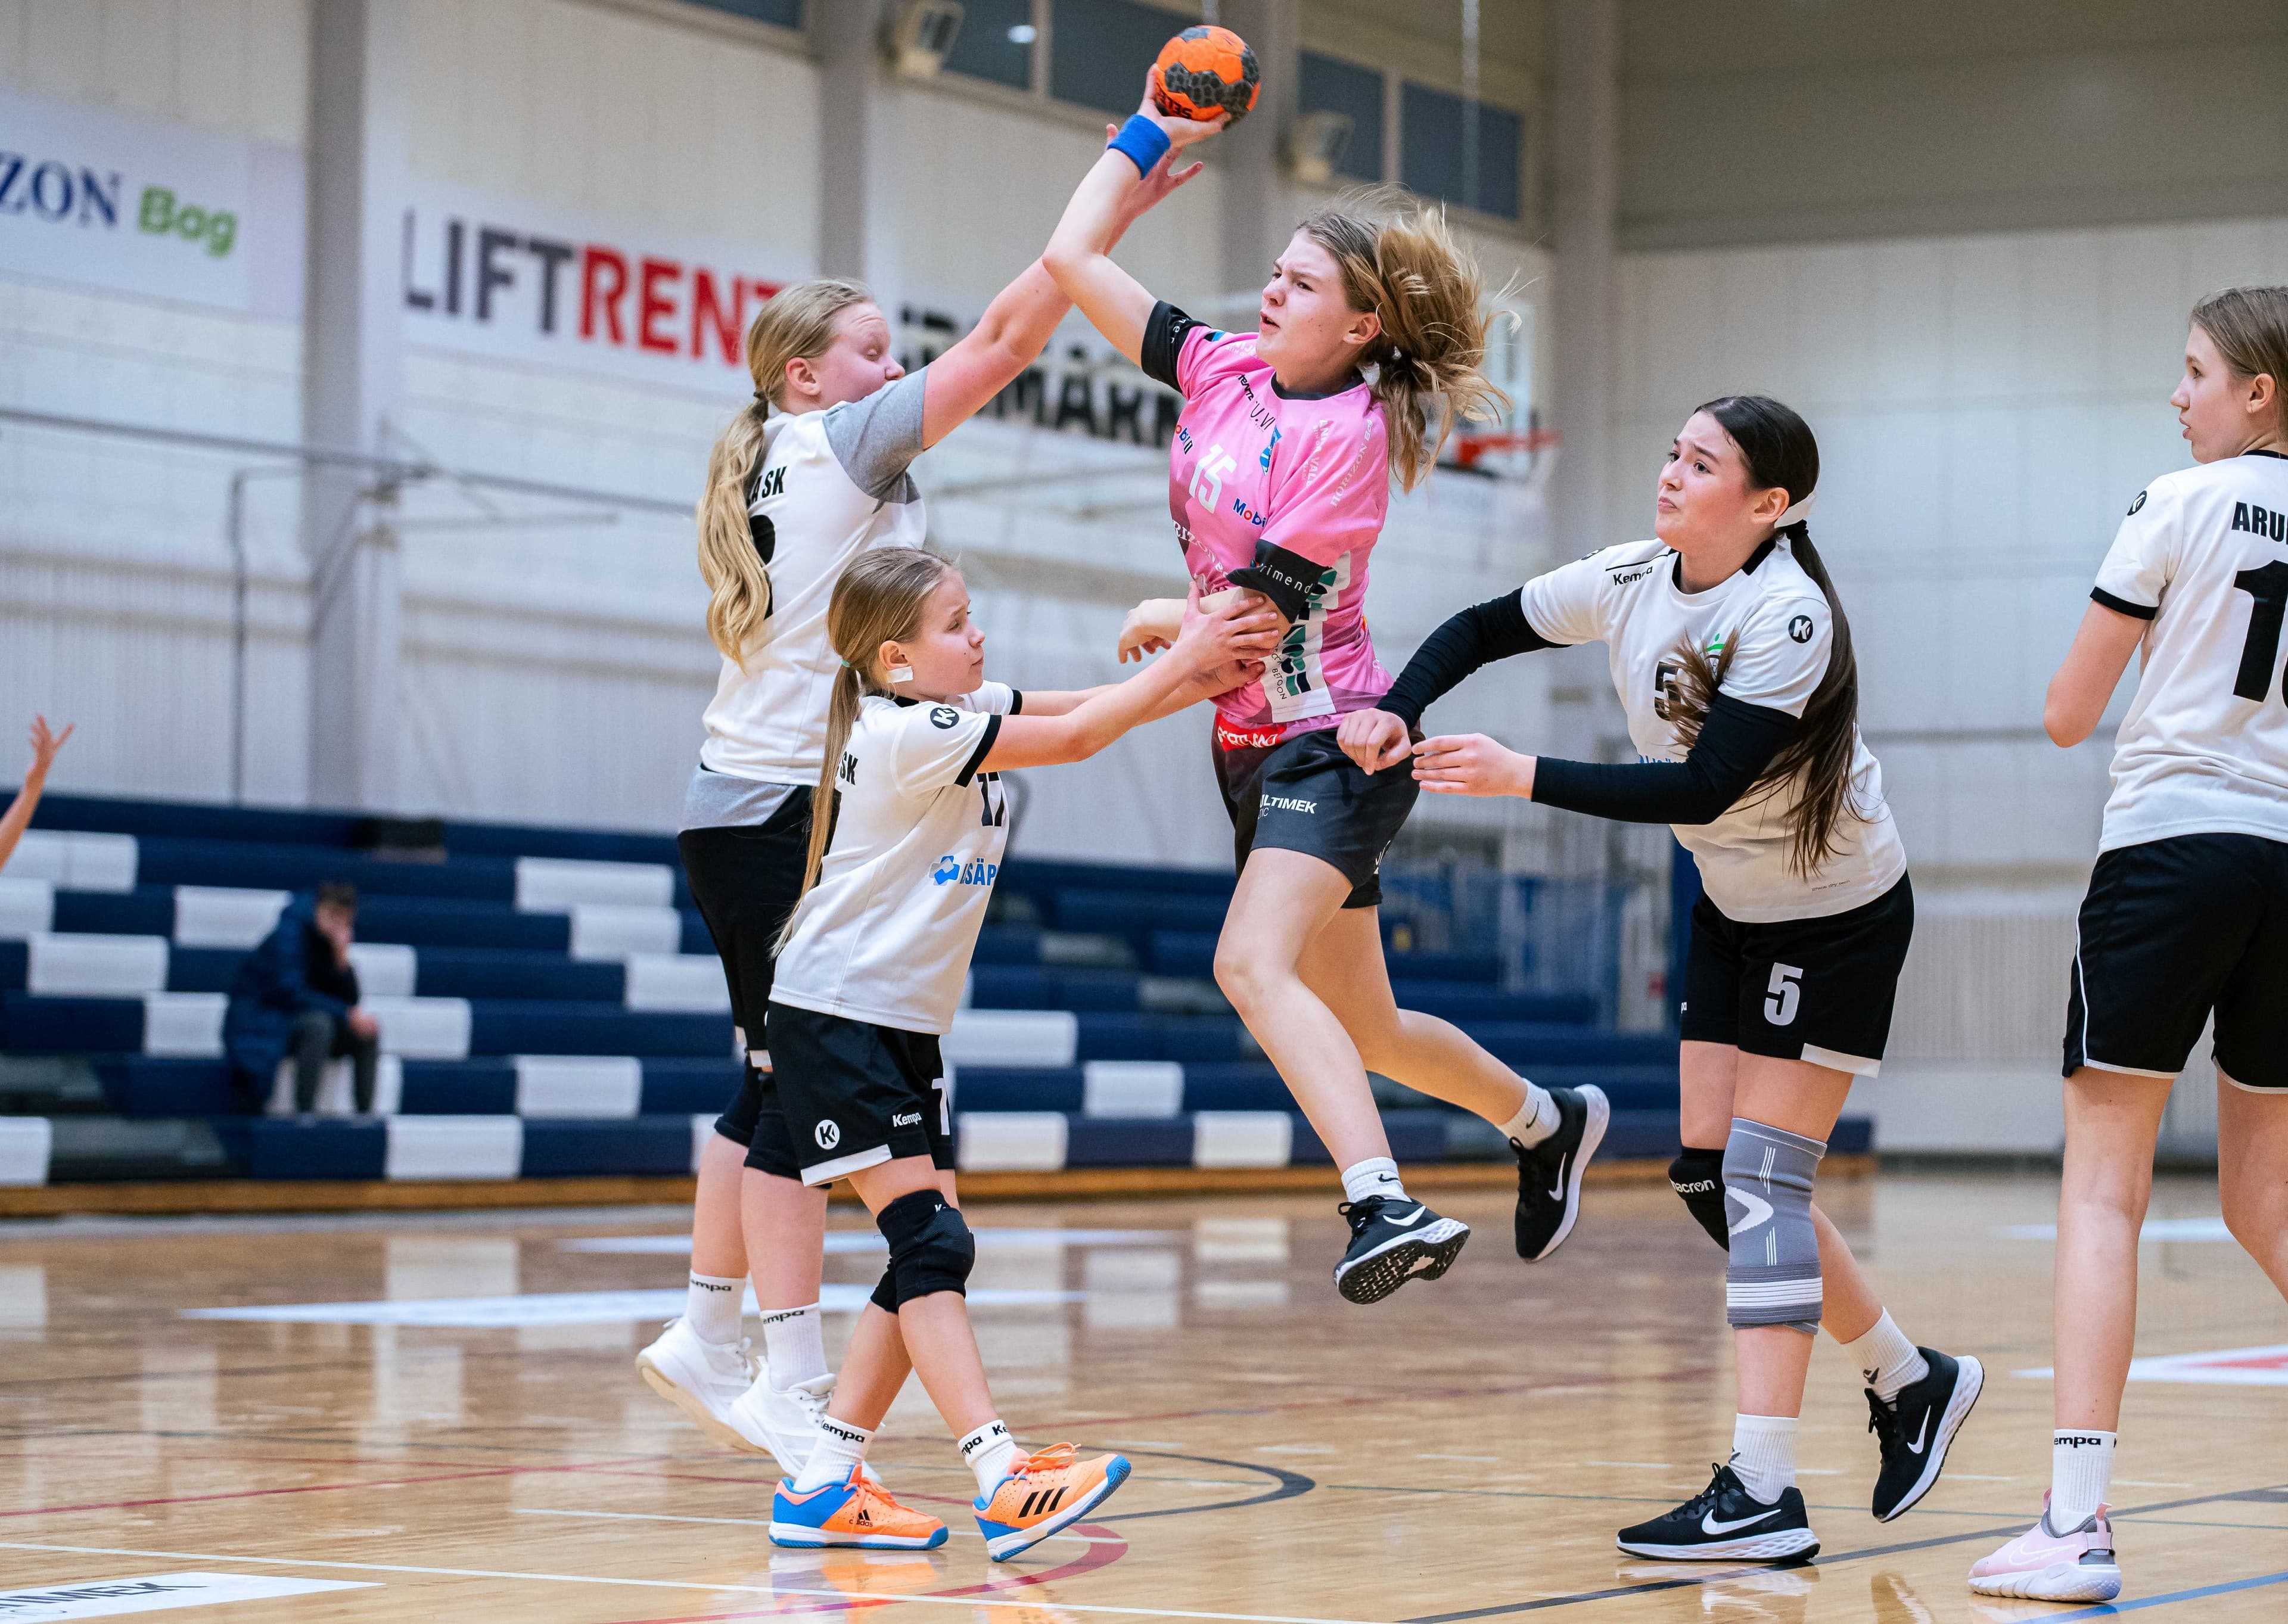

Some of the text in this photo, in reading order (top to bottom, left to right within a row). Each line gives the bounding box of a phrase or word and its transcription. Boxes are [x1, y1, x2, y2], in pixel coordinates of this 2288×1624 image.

[747, 466, 788, 505] ASK
[1189, 443, 1238, 514] 15
[2231, 501, 2288, 545] ARU
[1612, 566, 1653, 586] Kema
[2233, 559, 2288, 709] 1
[1272, 668, 1288, 700] BETOON
[1763, 962, 1804, 1026] 5
[893, 1112, 922, 1127] Kempa
[821, 1419, 866, 1444] empa
